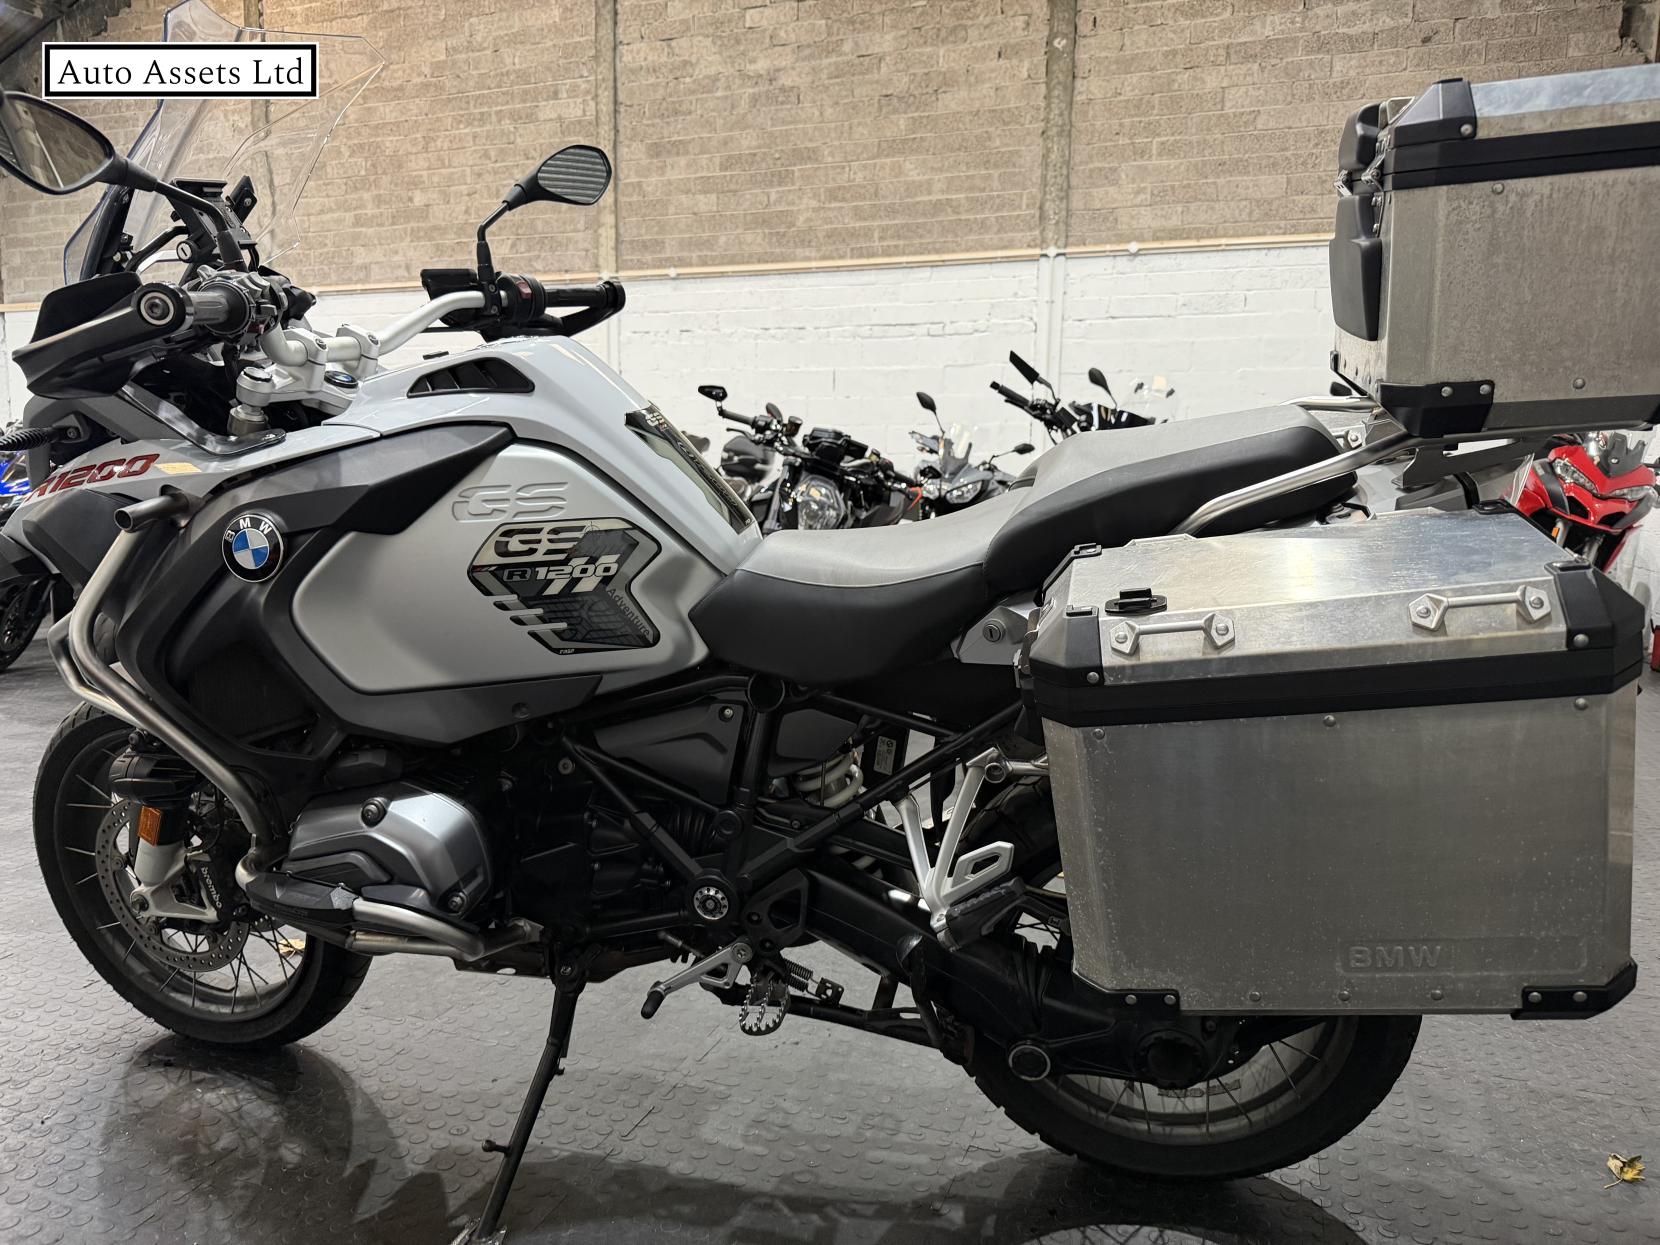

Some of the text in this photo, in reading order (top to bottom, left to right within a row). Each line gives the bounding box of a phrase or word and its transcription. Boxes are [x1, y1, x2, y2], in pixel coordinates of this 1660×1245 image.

[452, 481, 568, 524] GS
[224, 518, 273, 542] BMW
[493, 525, 587, 559] GS
[606, 587, 650, 638] Adventure
[200, 866, 222, 909] brembo
[1350, 945, 1441, 969] BMW
